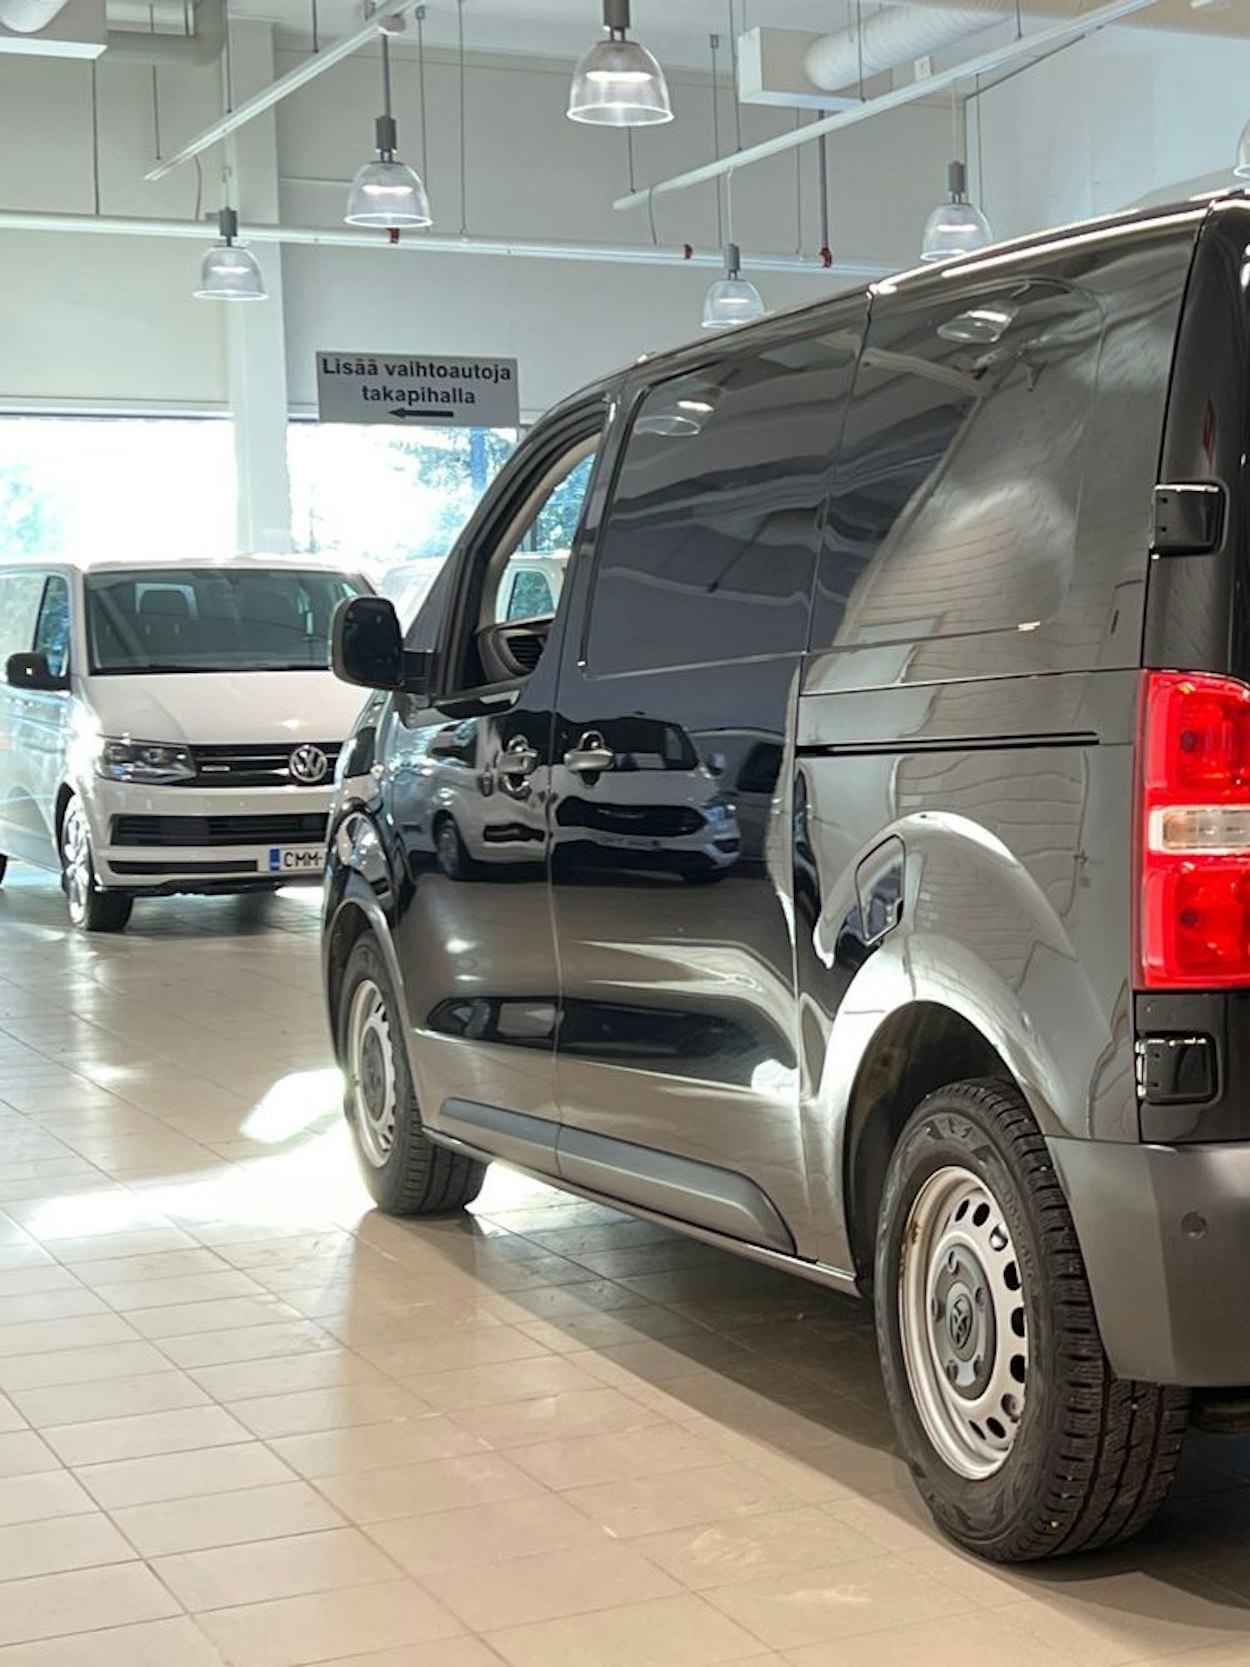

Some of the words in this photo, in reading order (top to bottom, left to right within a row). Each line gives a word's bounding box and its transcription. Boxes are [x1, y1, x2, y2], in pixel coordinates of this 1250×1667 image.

[322, 357, 379, 376] Lisää
[385, 361, 511, 384] vaihtoautoja
[362, 385, 476, 406] takapihalla
